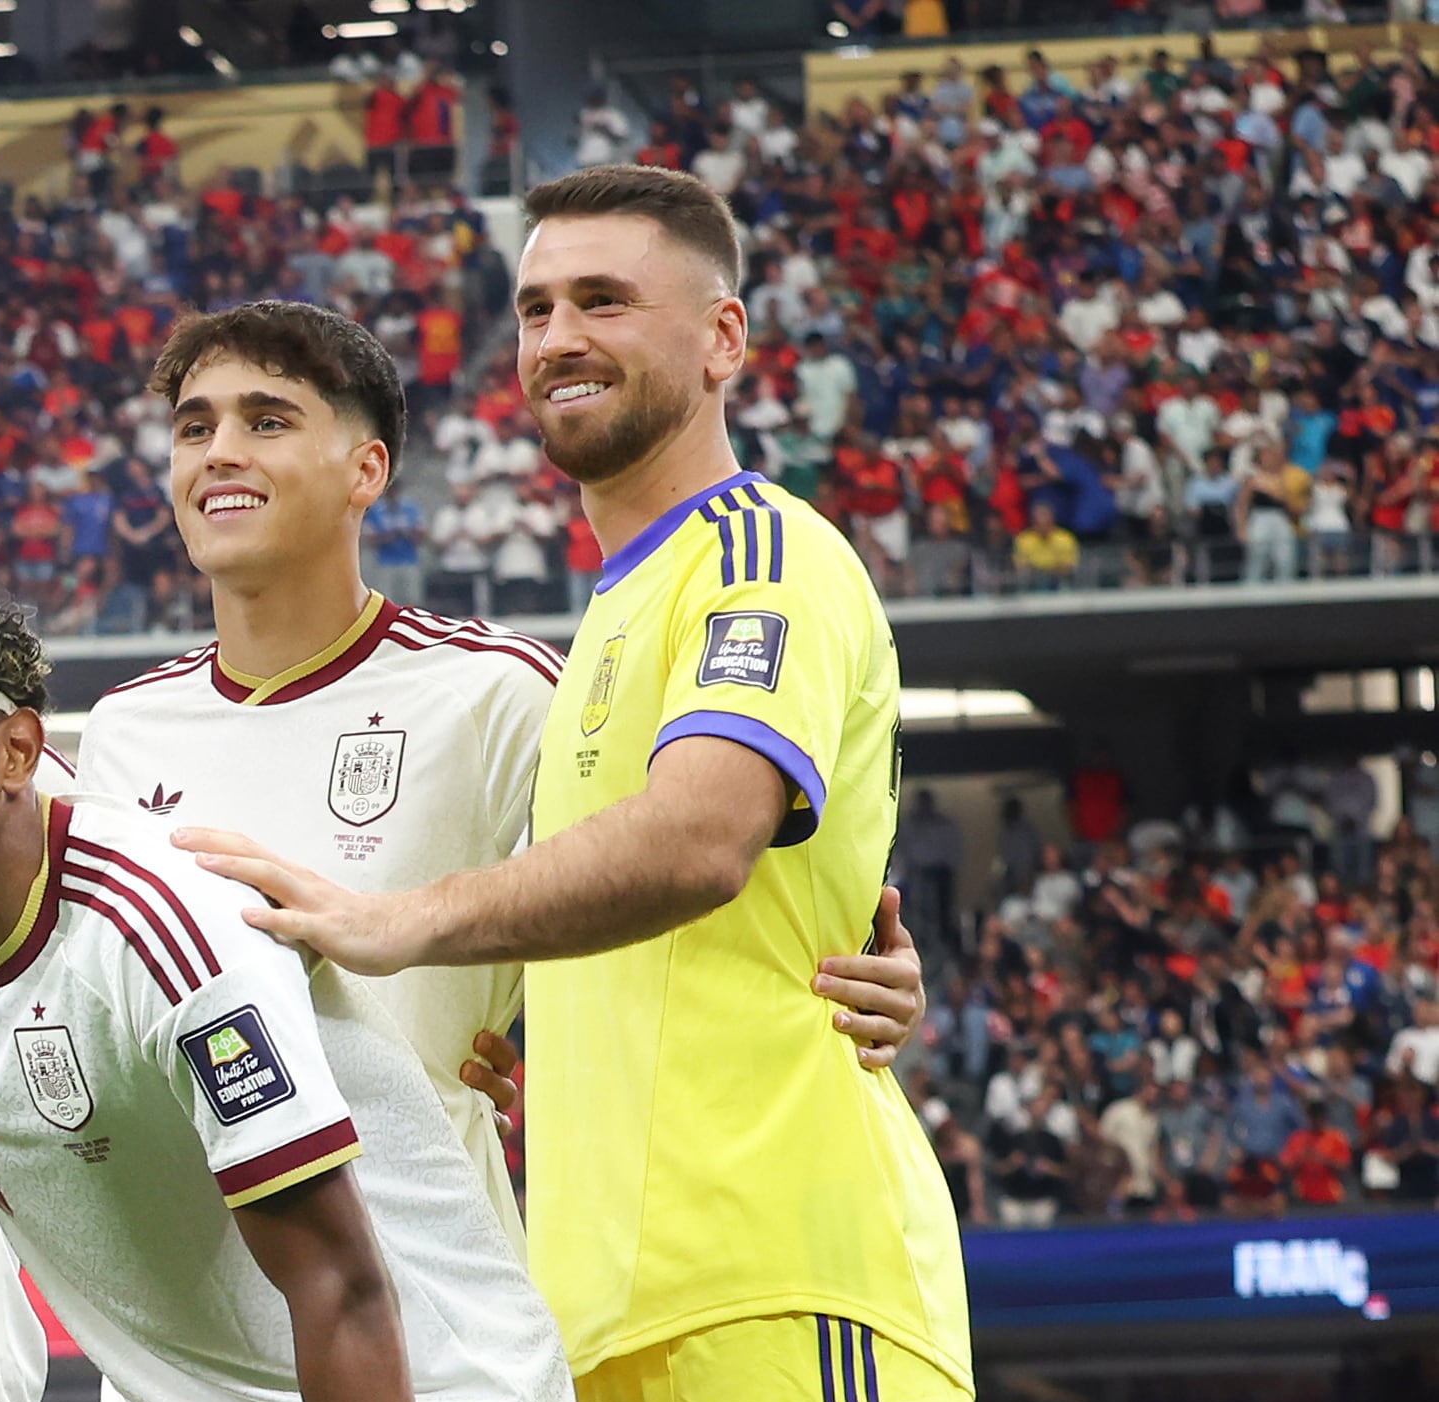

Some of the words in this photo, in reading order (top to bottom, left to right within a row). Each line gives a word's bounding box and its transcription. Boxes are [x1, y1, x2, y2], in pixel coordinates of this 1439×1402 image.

[709, 655, 770, 673] EDUCATION
[724, 667, 748, 678] FIFA
[217, 1066, 277, 1104] EDUCATION
[240, 1091, 265, 1107] FIFA
